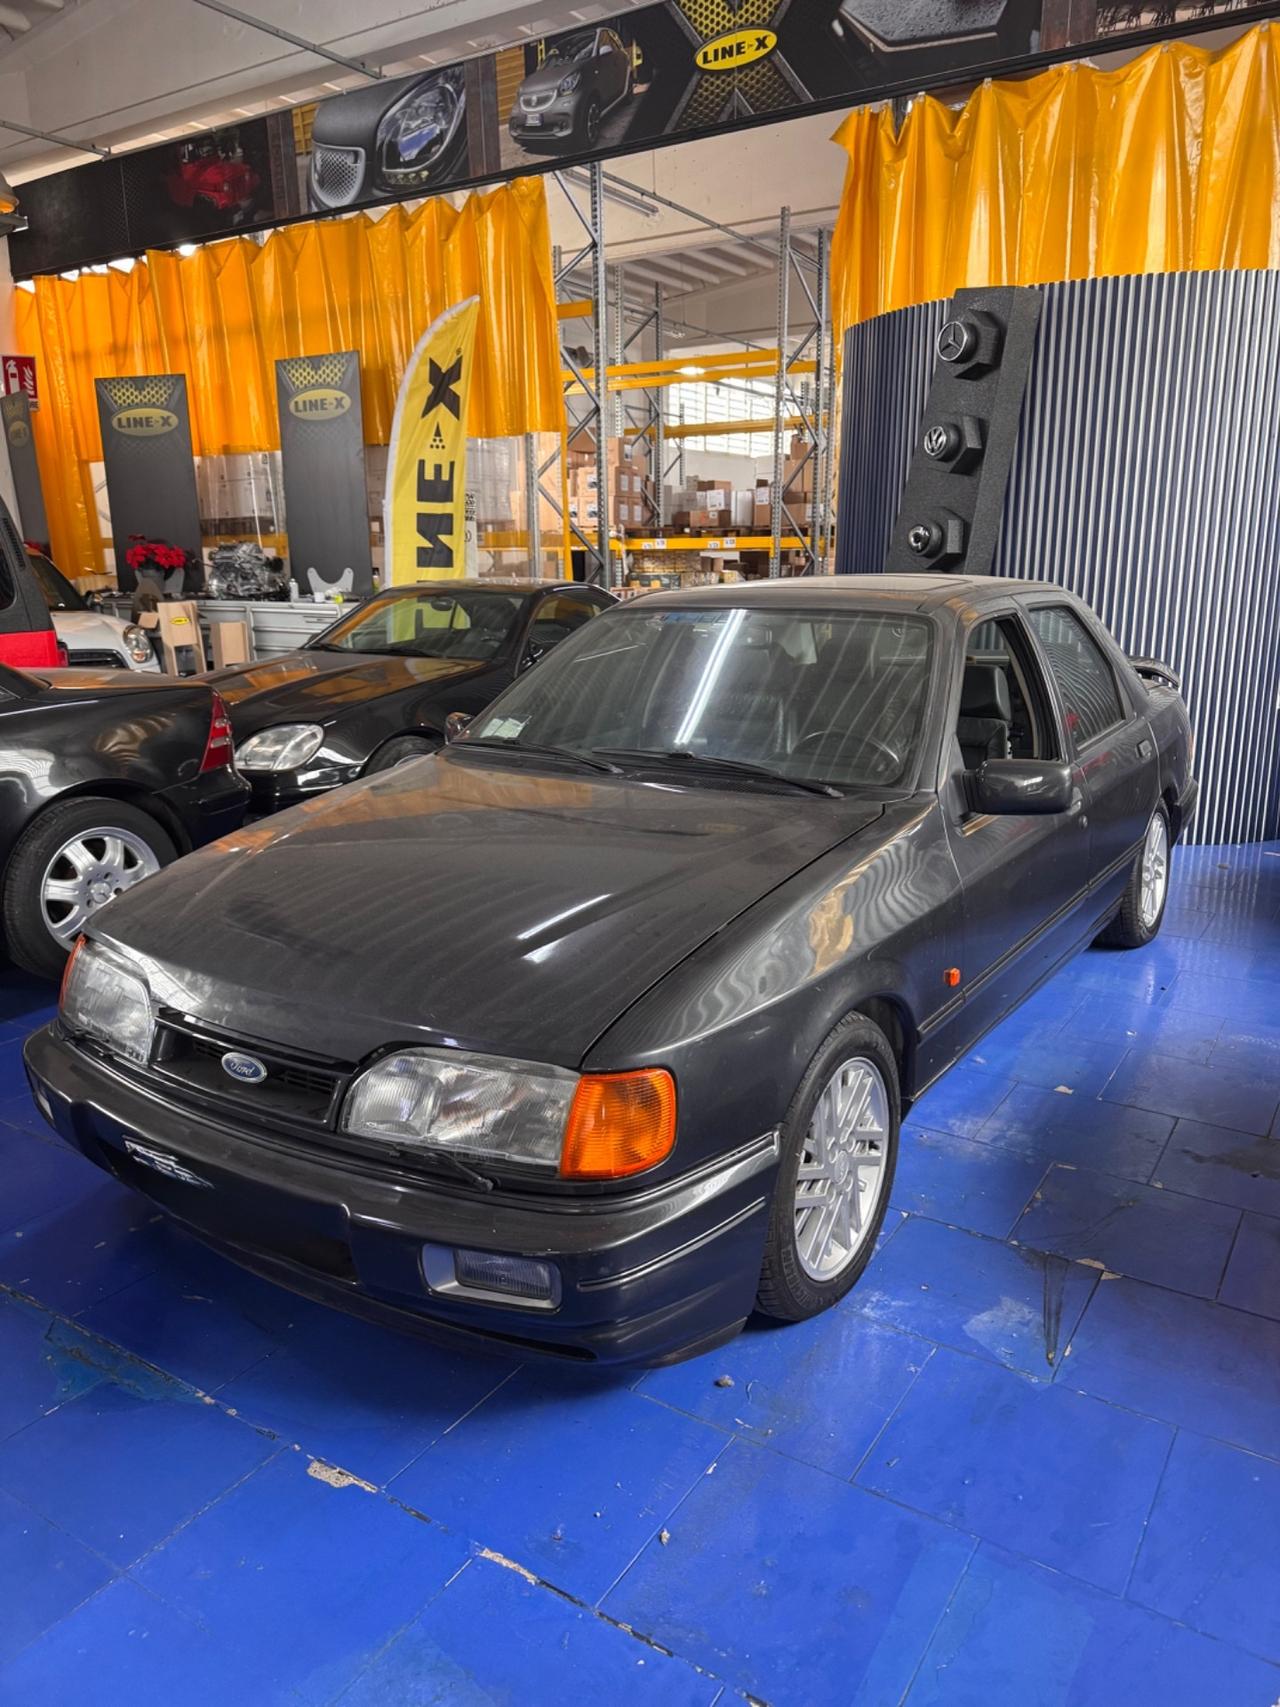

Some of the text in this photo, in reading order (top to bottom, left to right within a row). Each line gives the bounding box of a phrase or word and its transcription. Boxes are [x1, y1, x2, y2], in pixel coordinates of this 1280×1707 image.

[702, 35, 769, 64] LINE-X
[294, 396, 346, 413] LINE-X
[117, 415, 172, 429] LINE-X
[228, 1057, 258, 1078] Ford
